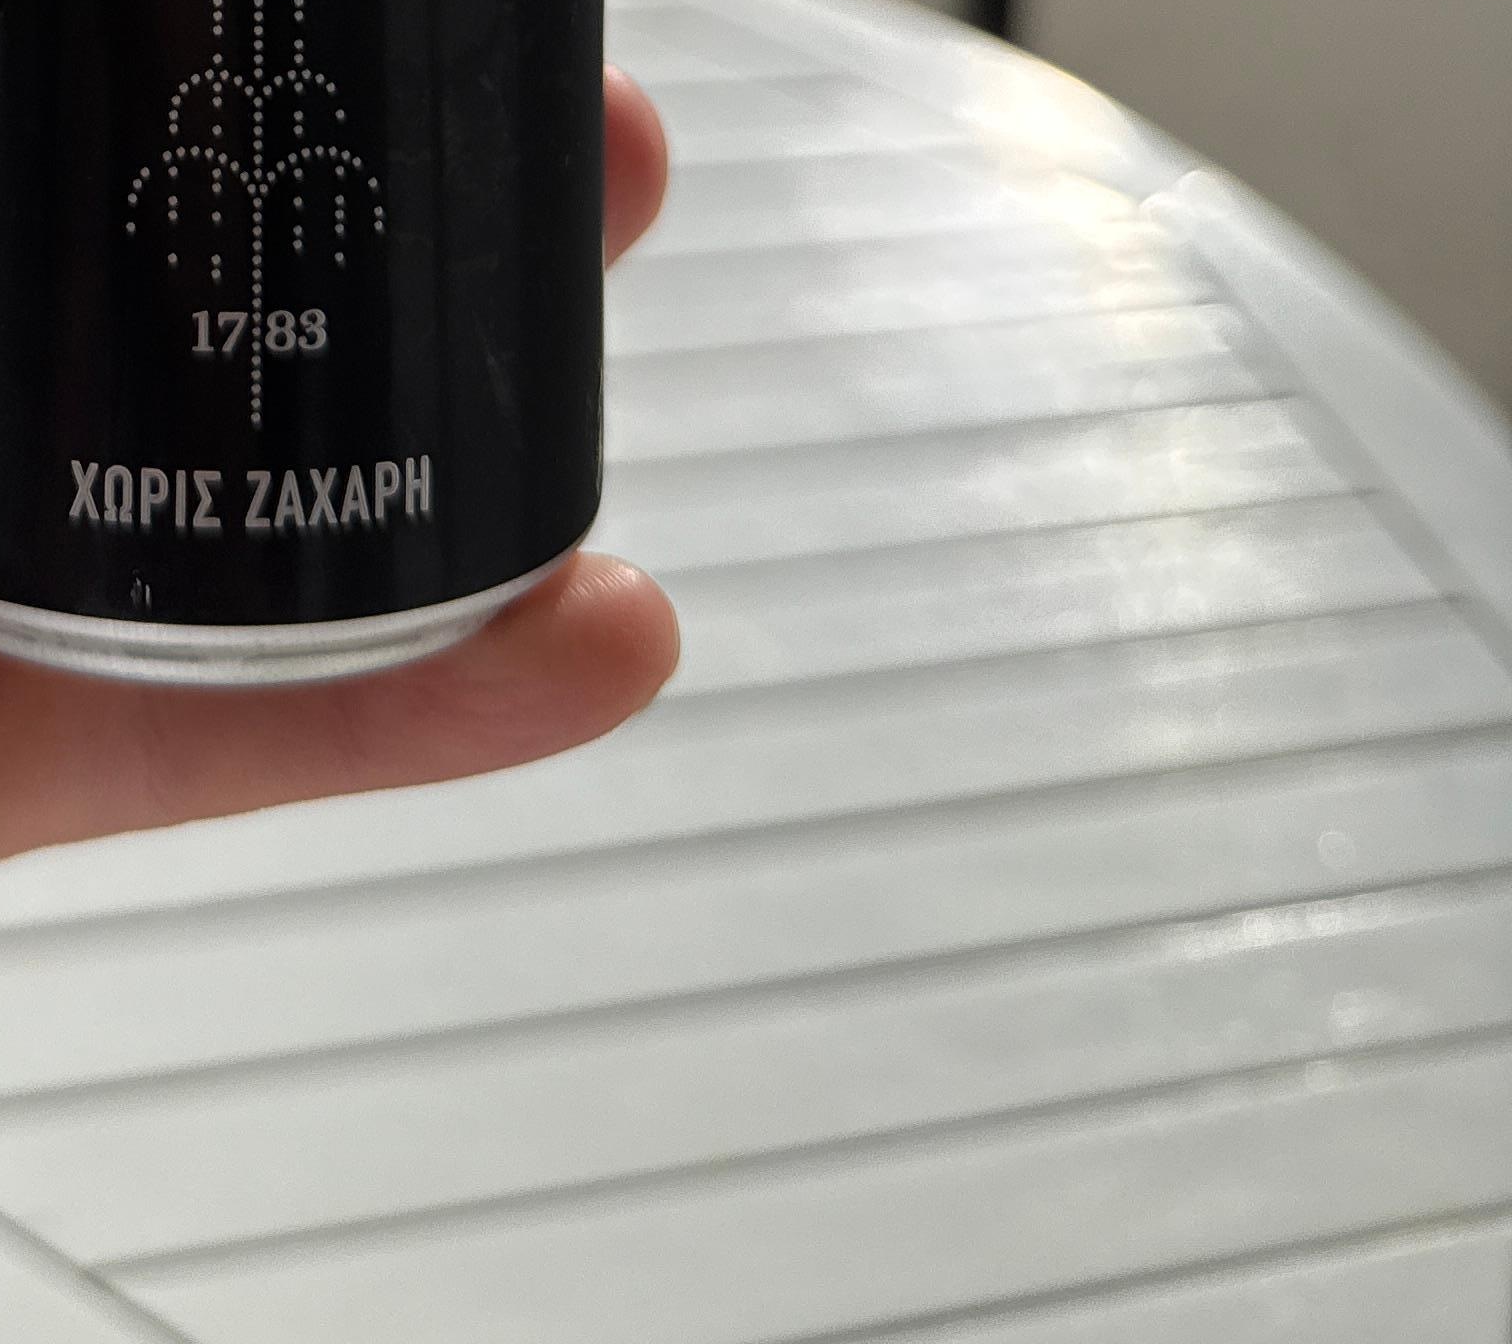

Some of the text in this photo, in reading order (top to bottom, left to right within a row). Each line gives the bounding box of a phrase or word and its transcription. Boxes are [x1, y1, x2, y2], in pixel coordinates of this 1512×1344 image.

[191, 307, 328, 353] 1783
[68, 453, 431, 529] ΧΩΡΙΣ ΖΑΧΑΡΗ
